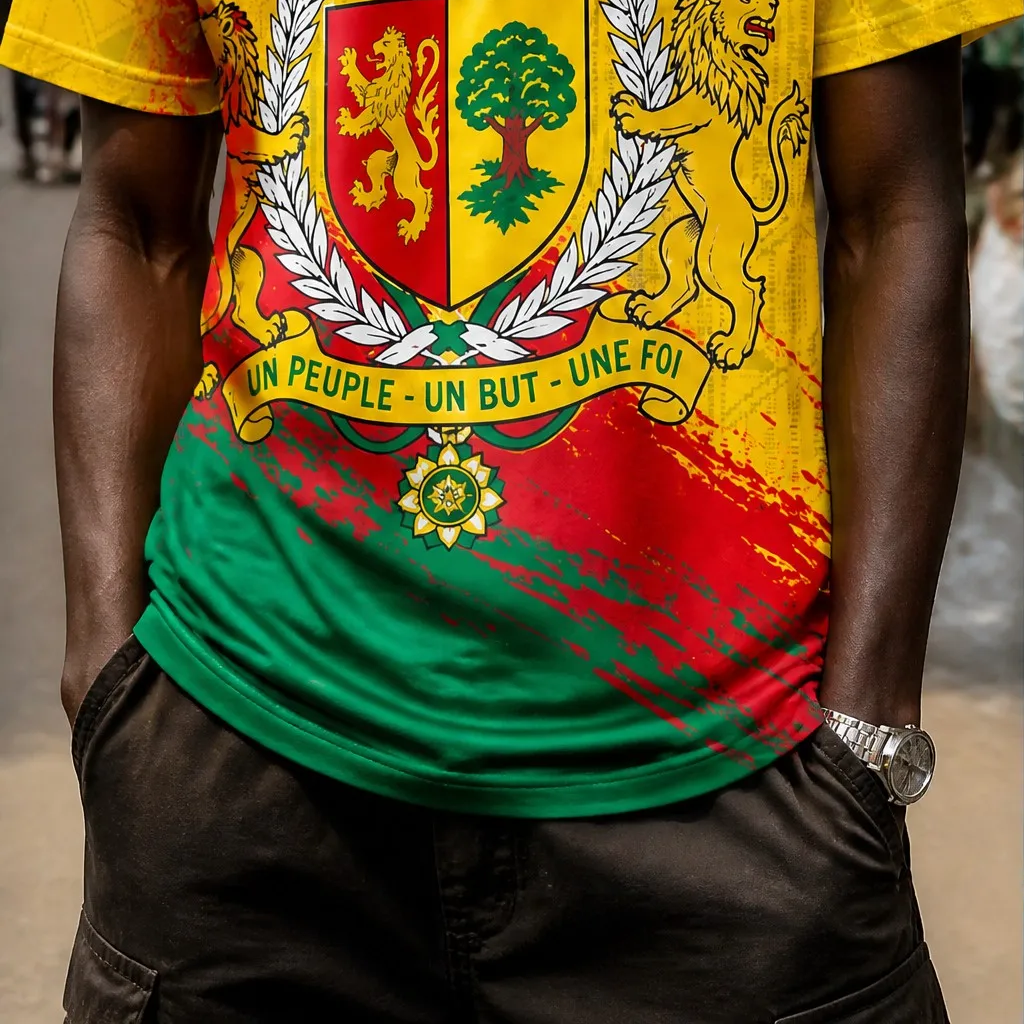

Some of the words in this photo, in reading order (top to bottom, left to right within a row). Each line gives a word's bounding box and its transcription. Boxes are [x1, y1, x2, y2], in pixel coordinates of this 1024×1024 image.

[247, 357, 278, 397] UN
[287, 355, 395, 412] PEUPLE
[424, 380, 466, 413] UN
[479, 371, 539, 411] BUT
[568, 339, 631, 387] UNE
[641, 339, 683, 379] FOI
